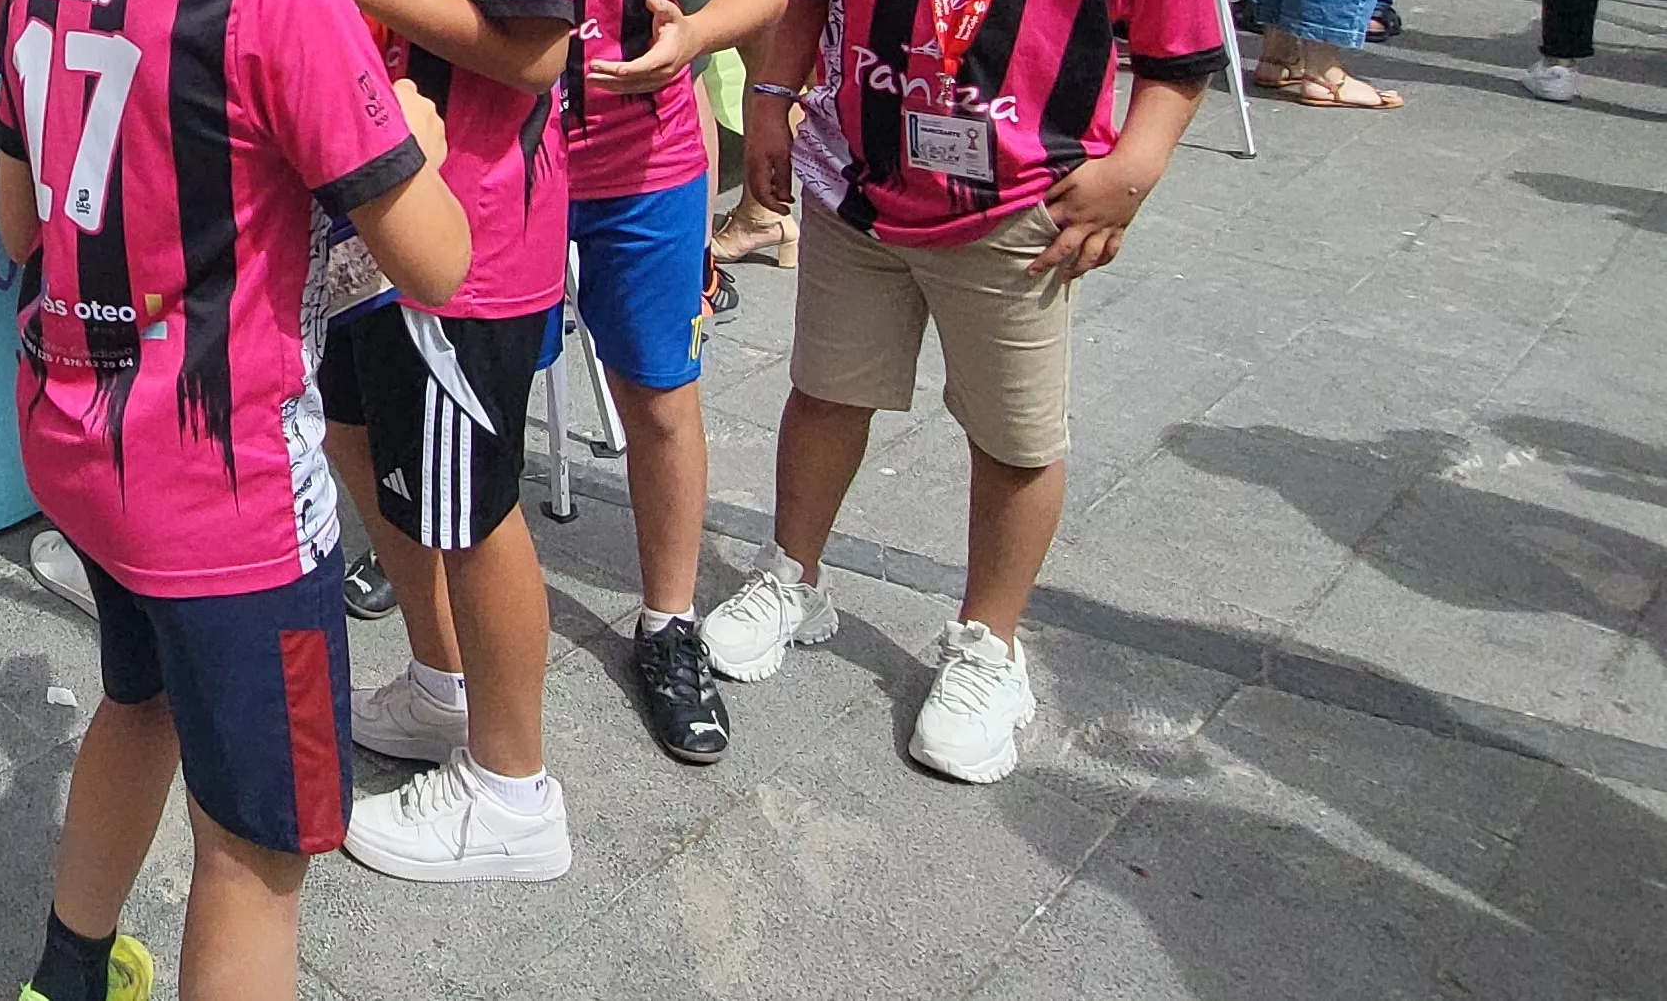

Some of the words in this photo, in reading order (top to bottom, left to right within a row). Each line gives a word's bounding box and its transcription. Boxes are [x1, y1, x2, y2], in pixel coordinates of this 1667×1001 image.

[850, 44, 1020, 123] Panza
[12, 20, 143, 232] 17
[73, 300, 137, 323] oteo
[118, 357, 134, 368] 64
